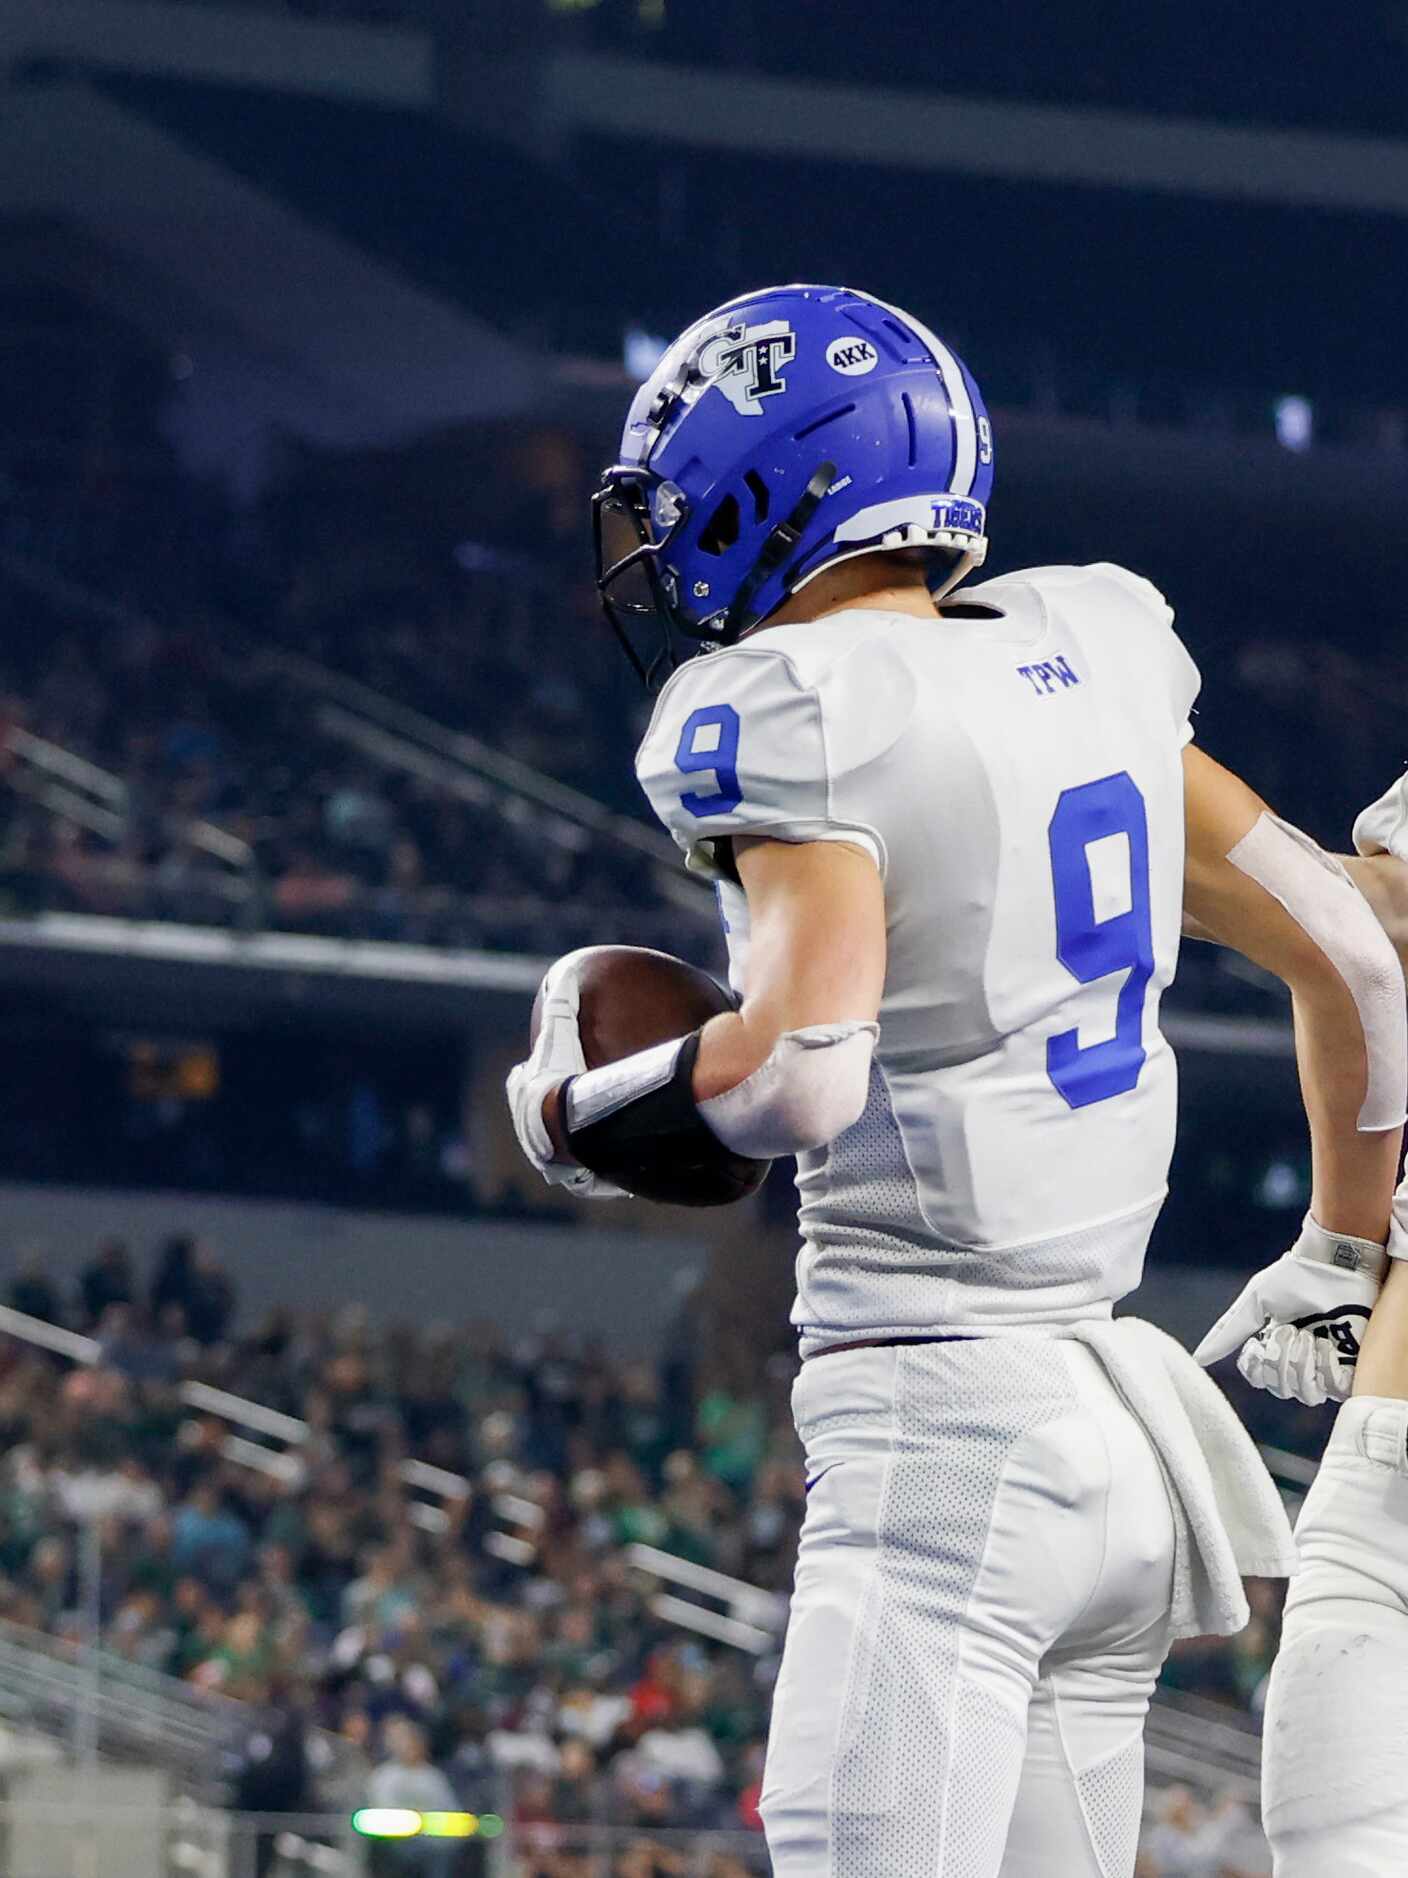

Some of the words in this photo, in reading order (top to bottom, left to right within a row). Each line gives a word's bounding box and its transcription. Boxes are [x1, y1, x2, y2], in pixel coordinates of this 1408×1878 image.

[832, 340, 876, 367] 4KK
[1017, 656, 1079, 695] TPW
[674, 703, 743, 818] 9
[1047, 770, 1155, 1109] 9
